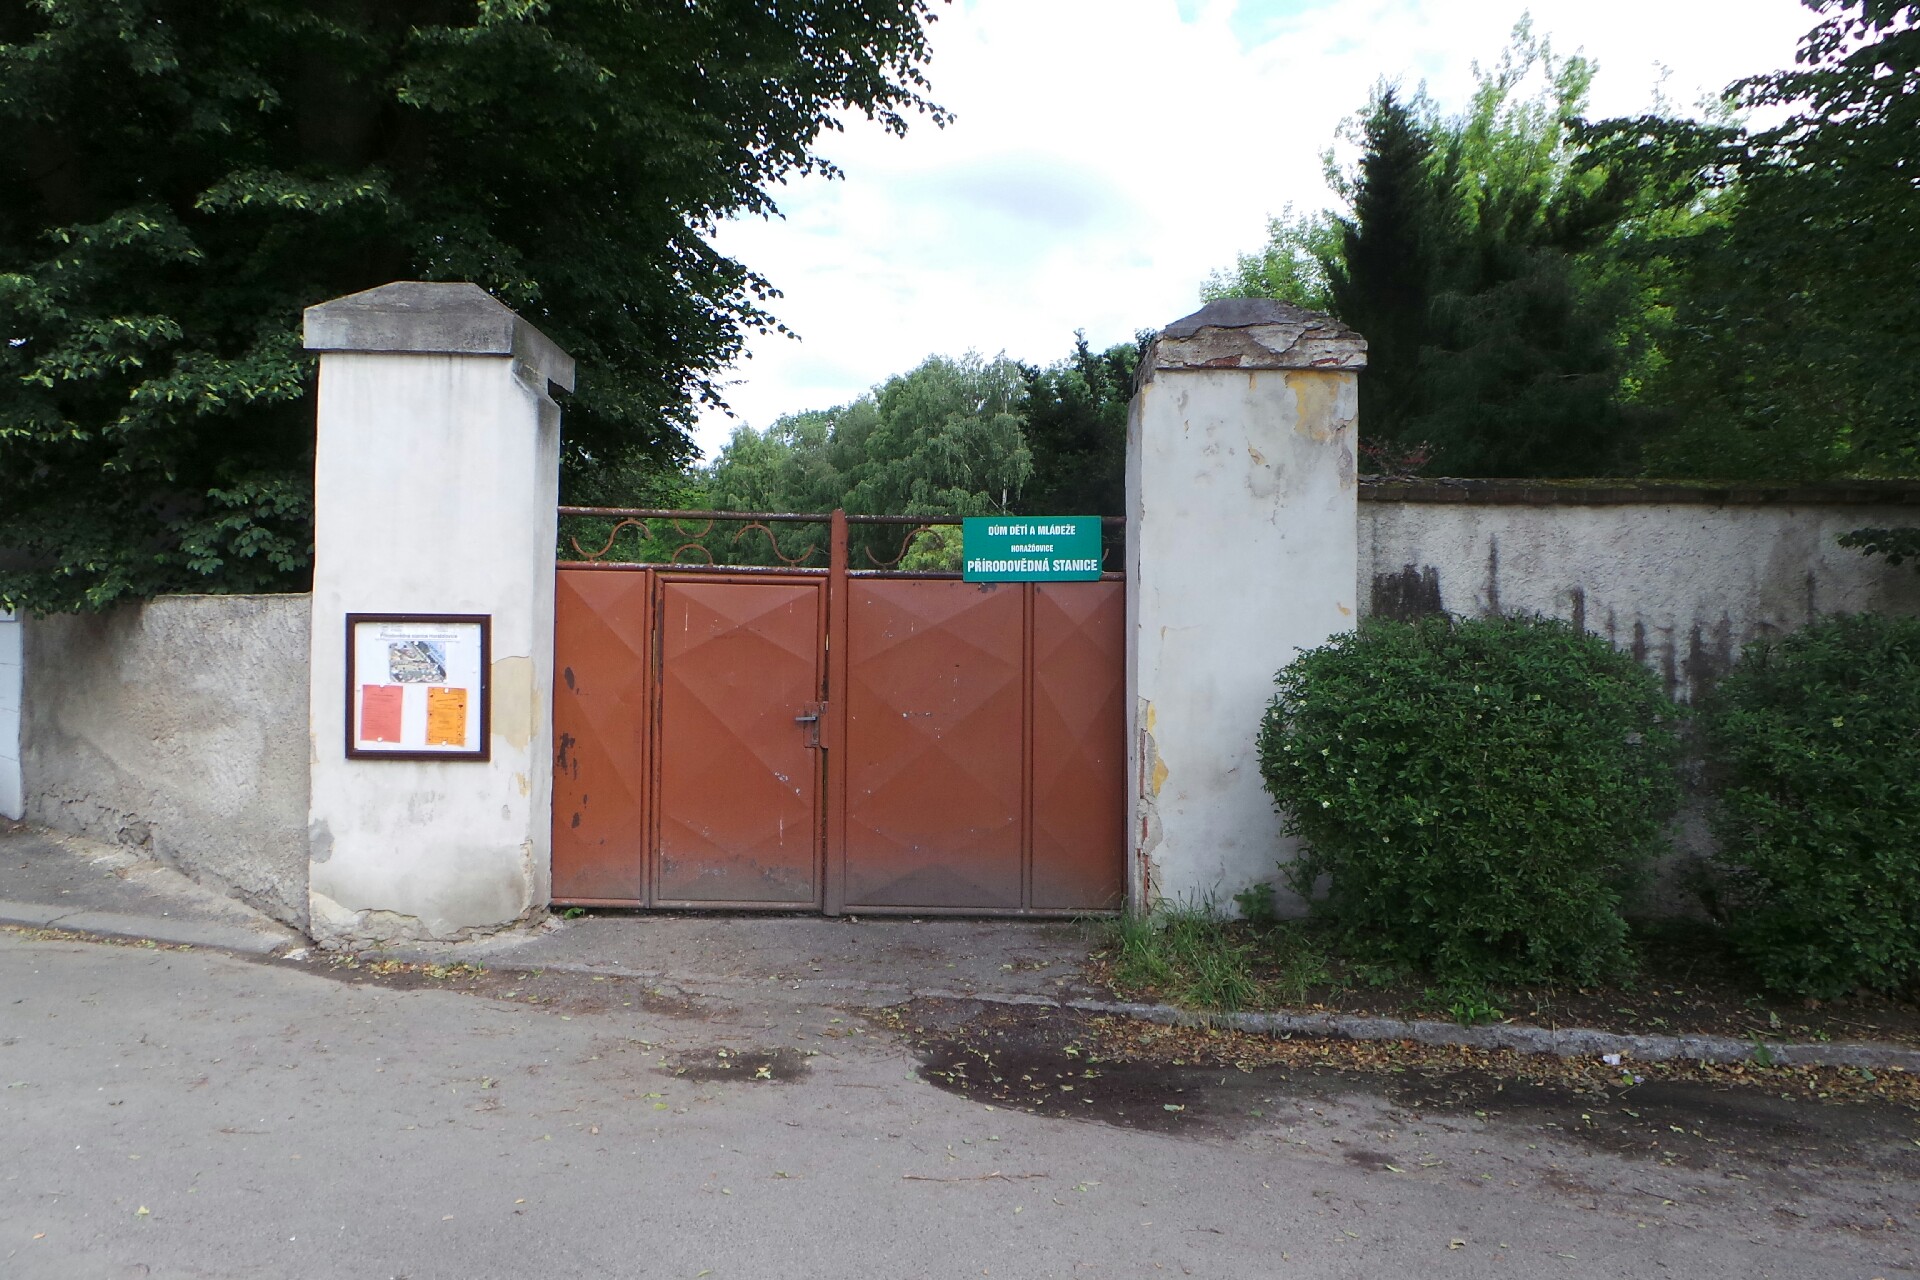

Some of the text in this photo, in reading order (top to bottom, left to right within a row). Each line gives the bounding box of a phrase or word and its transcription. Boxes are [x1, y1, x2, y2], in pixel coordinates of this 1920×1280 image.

[988, 524, 1076, 535] DŮM DĚTÍ A MLÁDEŽE
[967, 558, 1098, 573] PŘÍRODOVĚDNÁ STANICE
